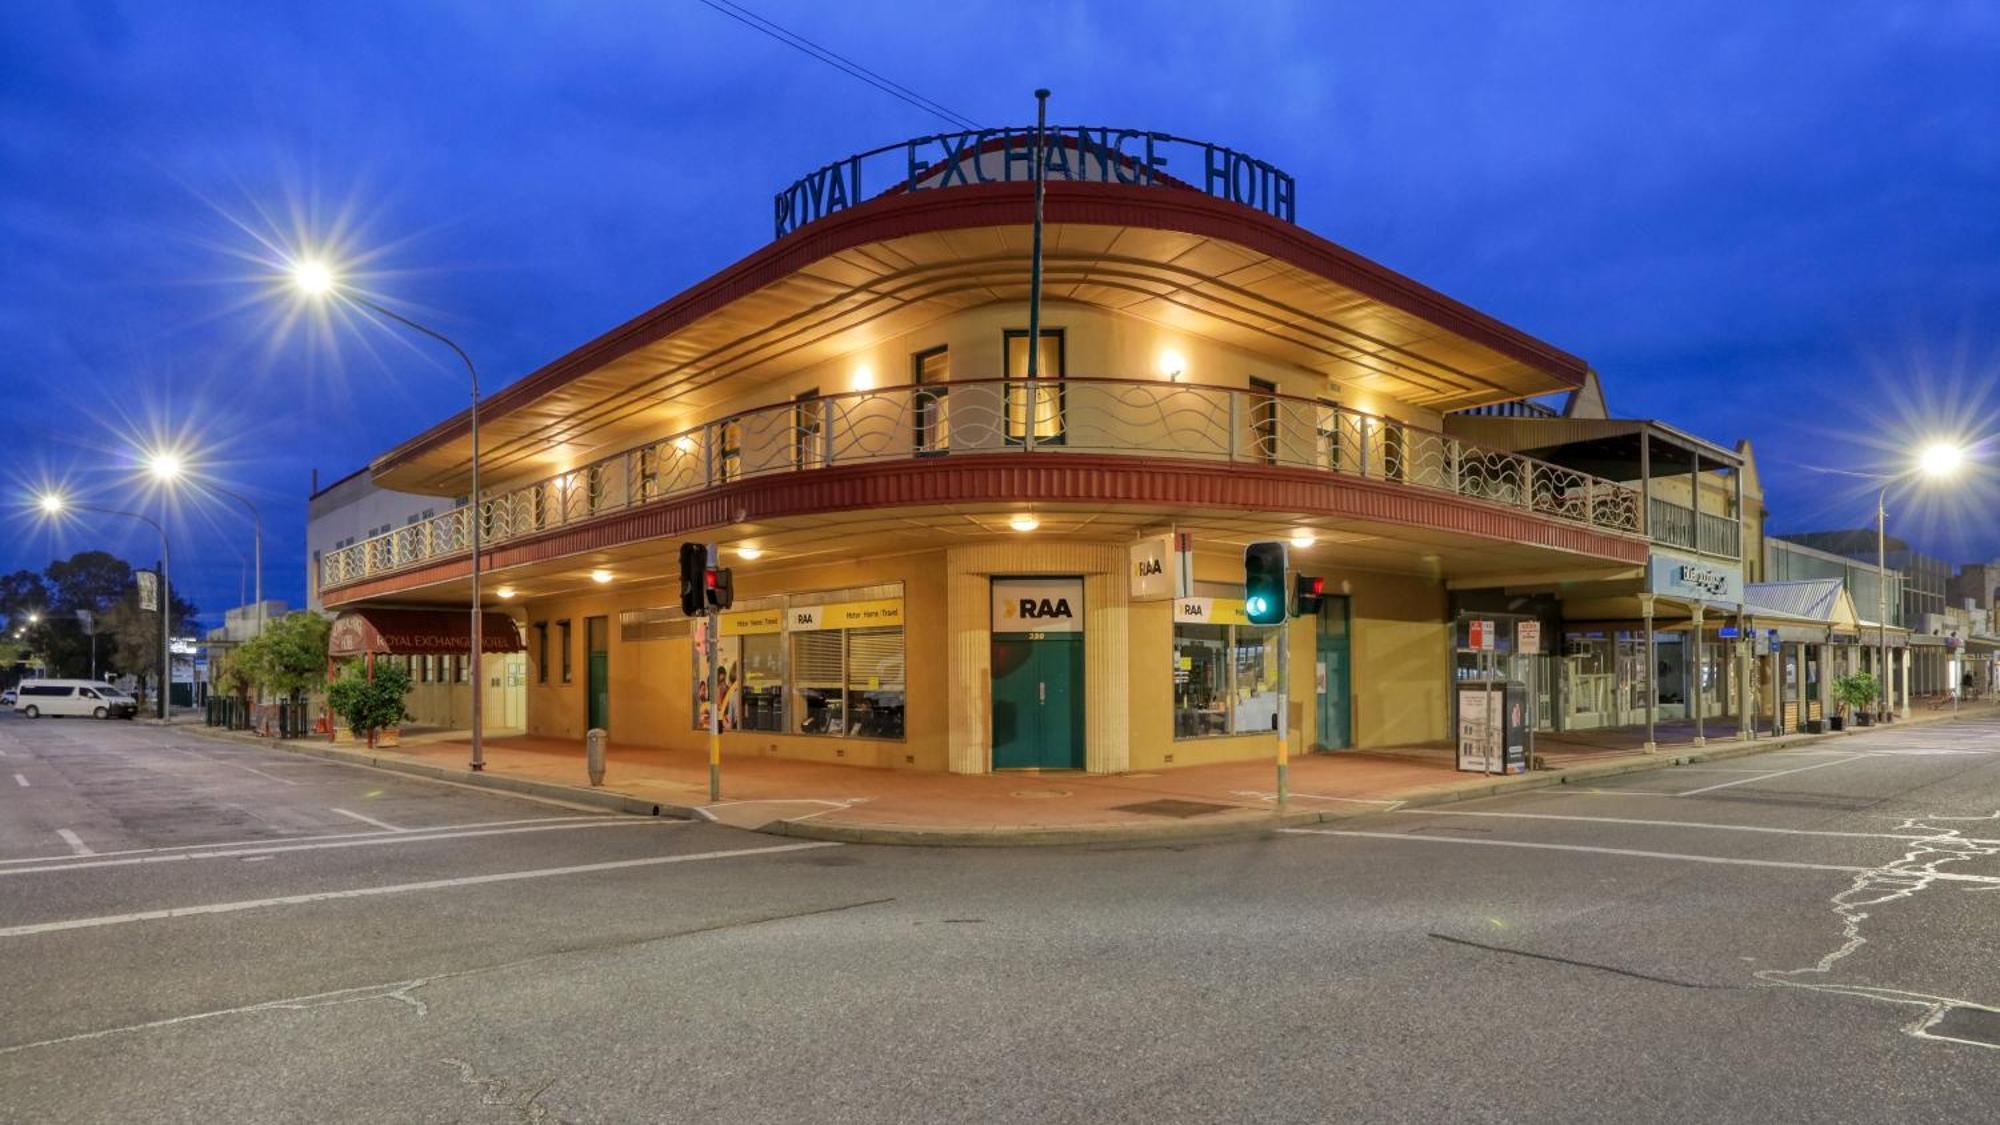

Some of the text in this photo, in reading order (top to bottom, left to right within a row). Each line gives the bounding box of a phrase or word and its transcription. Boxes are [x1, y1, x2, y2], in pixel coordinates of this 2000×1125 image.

[907, 126, 1171, 192] EXCHANGE
[1139, 559, 1162, 577] RAA
[1019, 598, 1073, 618] RAA
[1184, 604, 1203, 616] RAA
[797, 614, 813, 624] RAA
[377, 633, 412, 647] ROYAL
